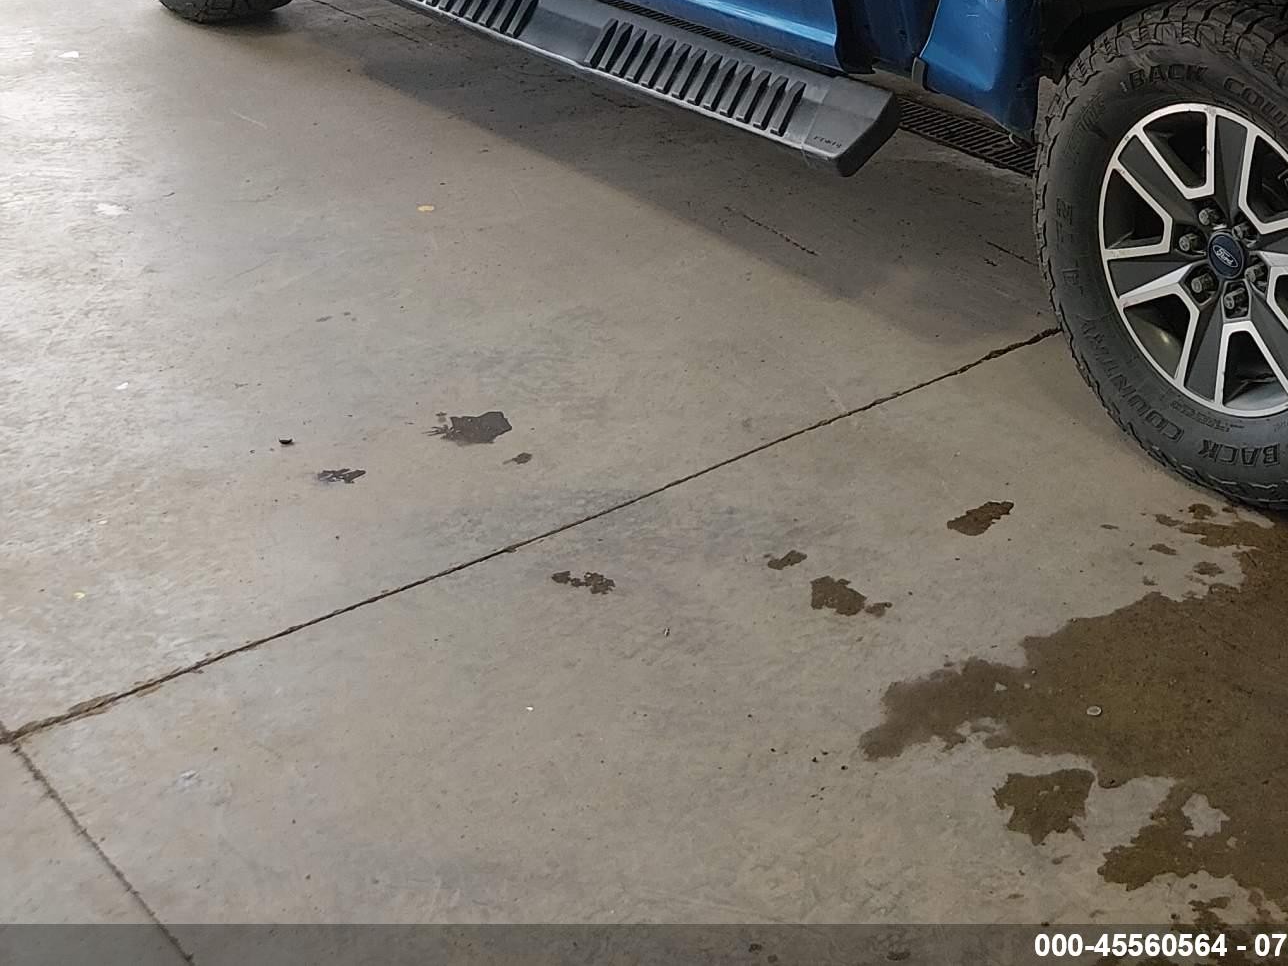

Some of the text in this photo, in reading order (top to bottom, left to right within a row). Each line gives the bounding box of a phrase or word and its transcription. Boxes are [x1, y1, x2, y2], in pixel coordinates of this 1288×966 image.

[1128, 64, 1209, 85] BACK
[1213, 246, 1235, 266] Ford
[1079, 314, 1184, 442] COUNTRY
[1200, 438, 1281, 467] BACK
